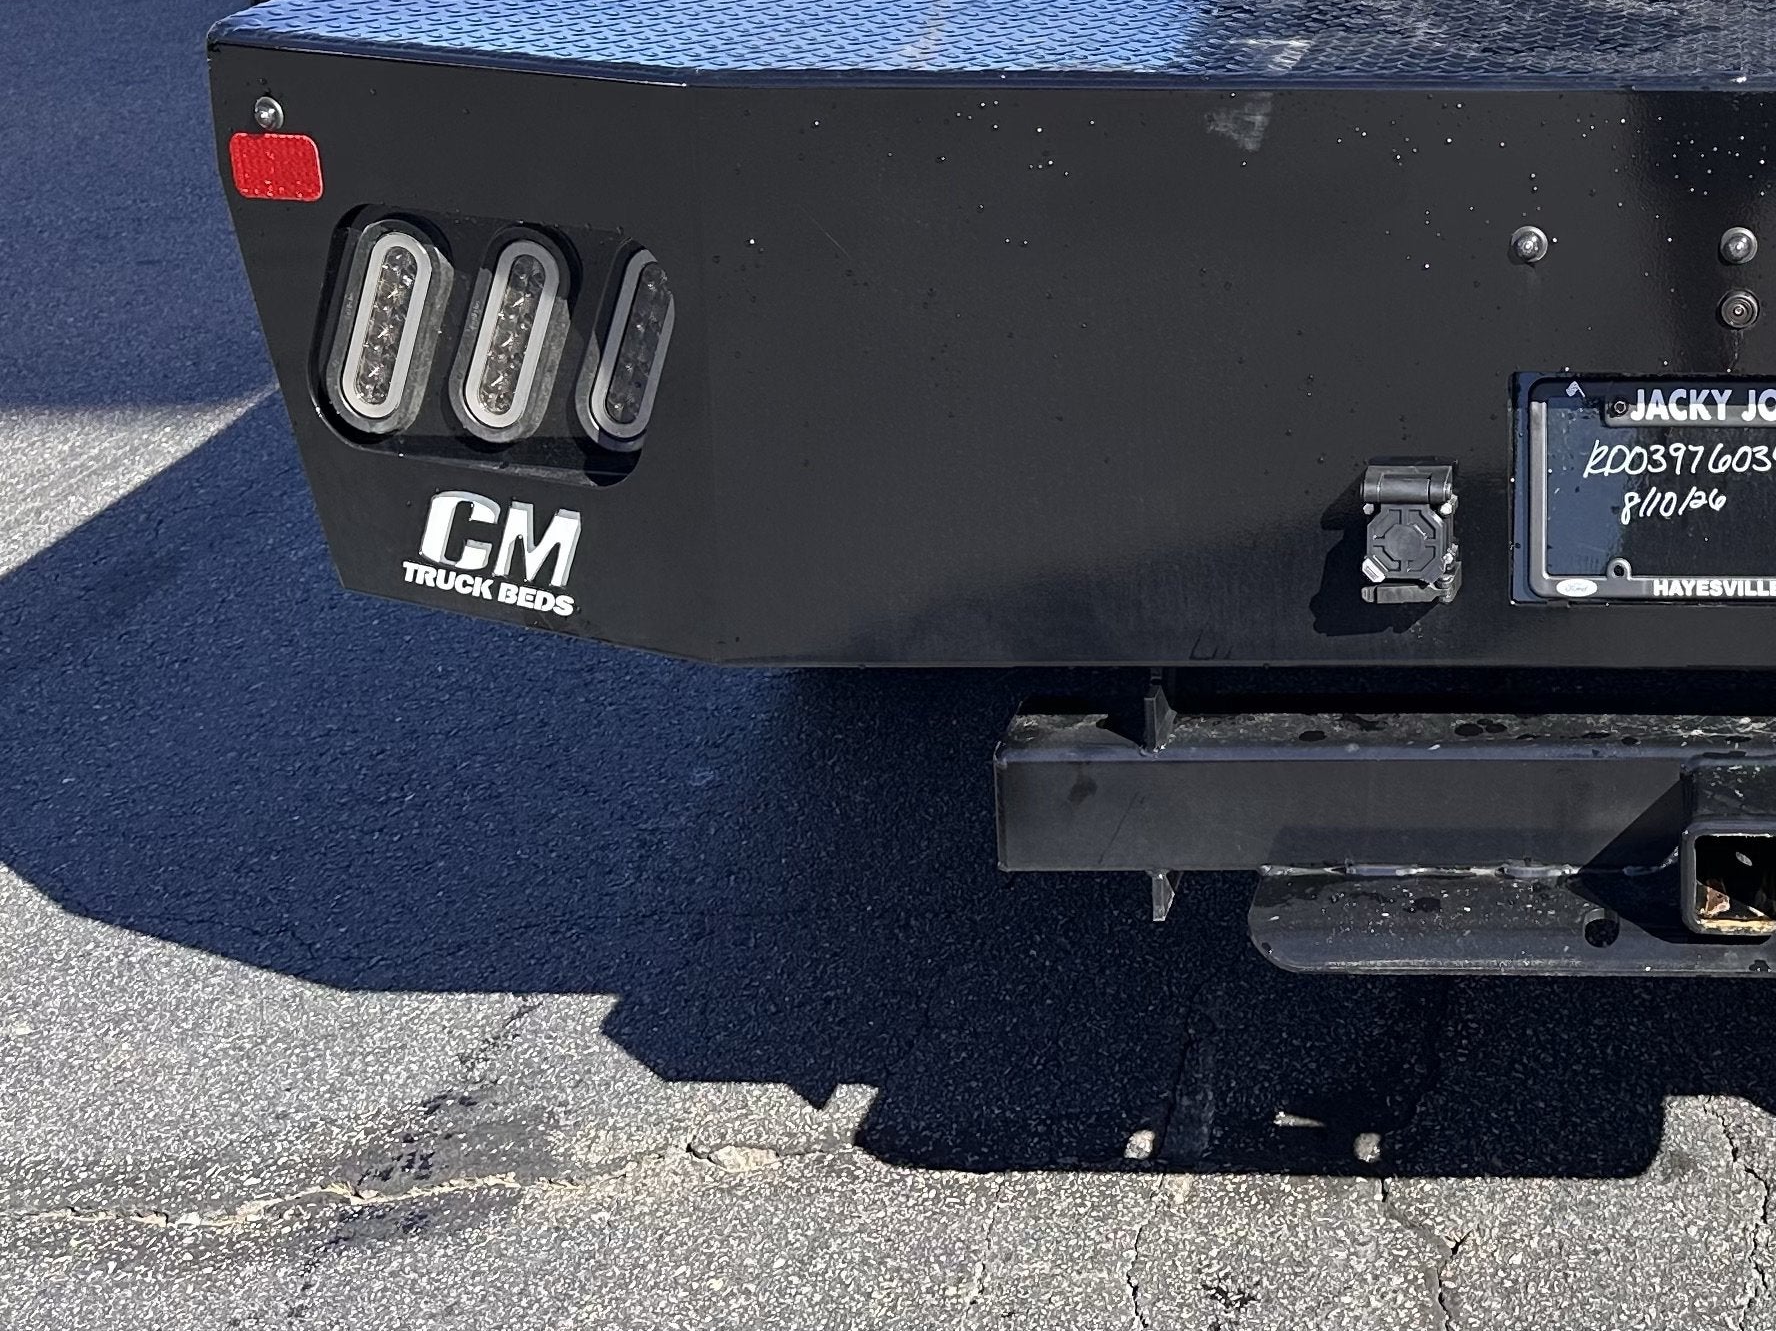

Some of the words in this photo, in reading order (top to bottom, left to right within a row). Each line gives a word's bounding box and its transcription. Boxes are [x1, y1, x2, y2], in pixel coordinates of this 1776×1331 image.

[1630, 388, 1733, 422] JACKY
[1620, 486, 1727, 525] 8/10/26
[418, 490, 582, 587] CM
[402, 561, 494, 600] TRUCK
[498, 582, 575, 616] BEDS
